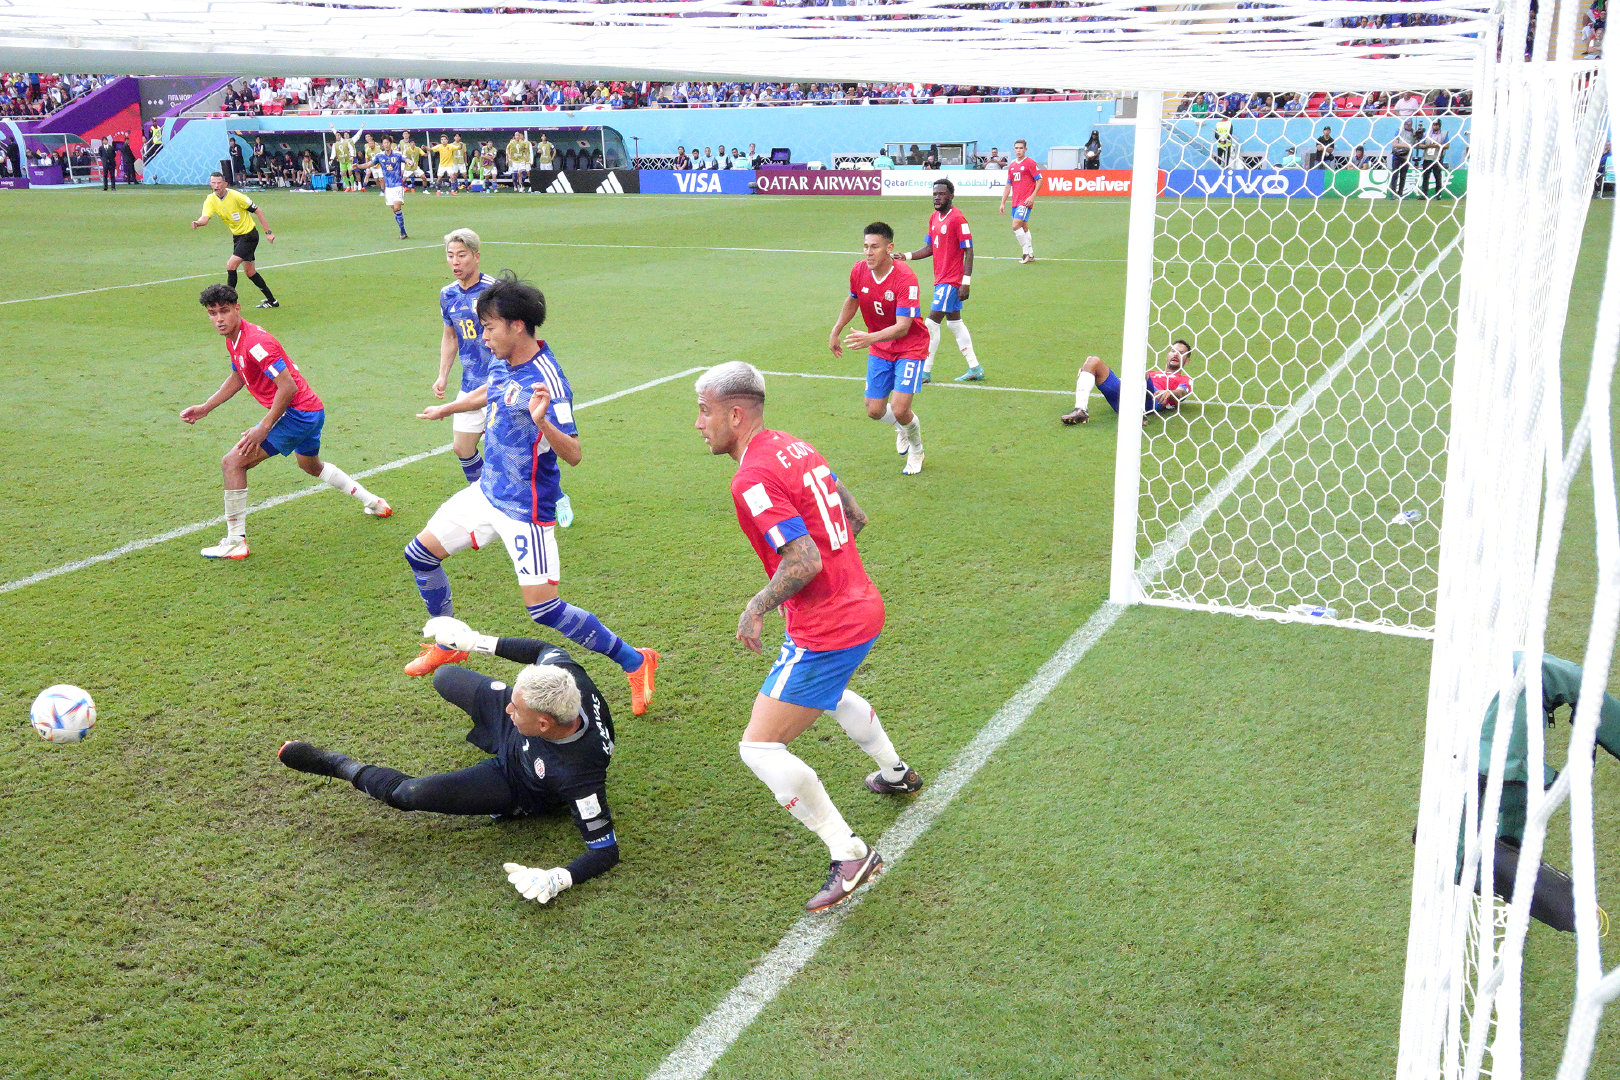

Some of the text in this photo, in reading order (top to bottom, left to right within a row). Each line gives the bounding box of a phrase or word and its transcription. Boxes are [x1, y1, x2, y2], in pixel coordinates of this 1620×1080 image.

[673, 172, 722, 193] VISA
[757, 175, 881, 191] QATAR AIRWAYS
[883, 179, 934, 189] QatarEnerg
[1013, 172, 1021, 181] 20
[1048, 176, 1130, 191] We Deliver
[1198, 170, 1290, 194] vivo
[933, 235, 939, 249] 4
[936, 286, 945, 300] 4
[873, 301, 885, 316] 6
[459, 319, 477, 339] 18
[903, 361, 915, 379] 6
[803, 464, 849, 551] 15
[515, 535, 528, 561] 9
